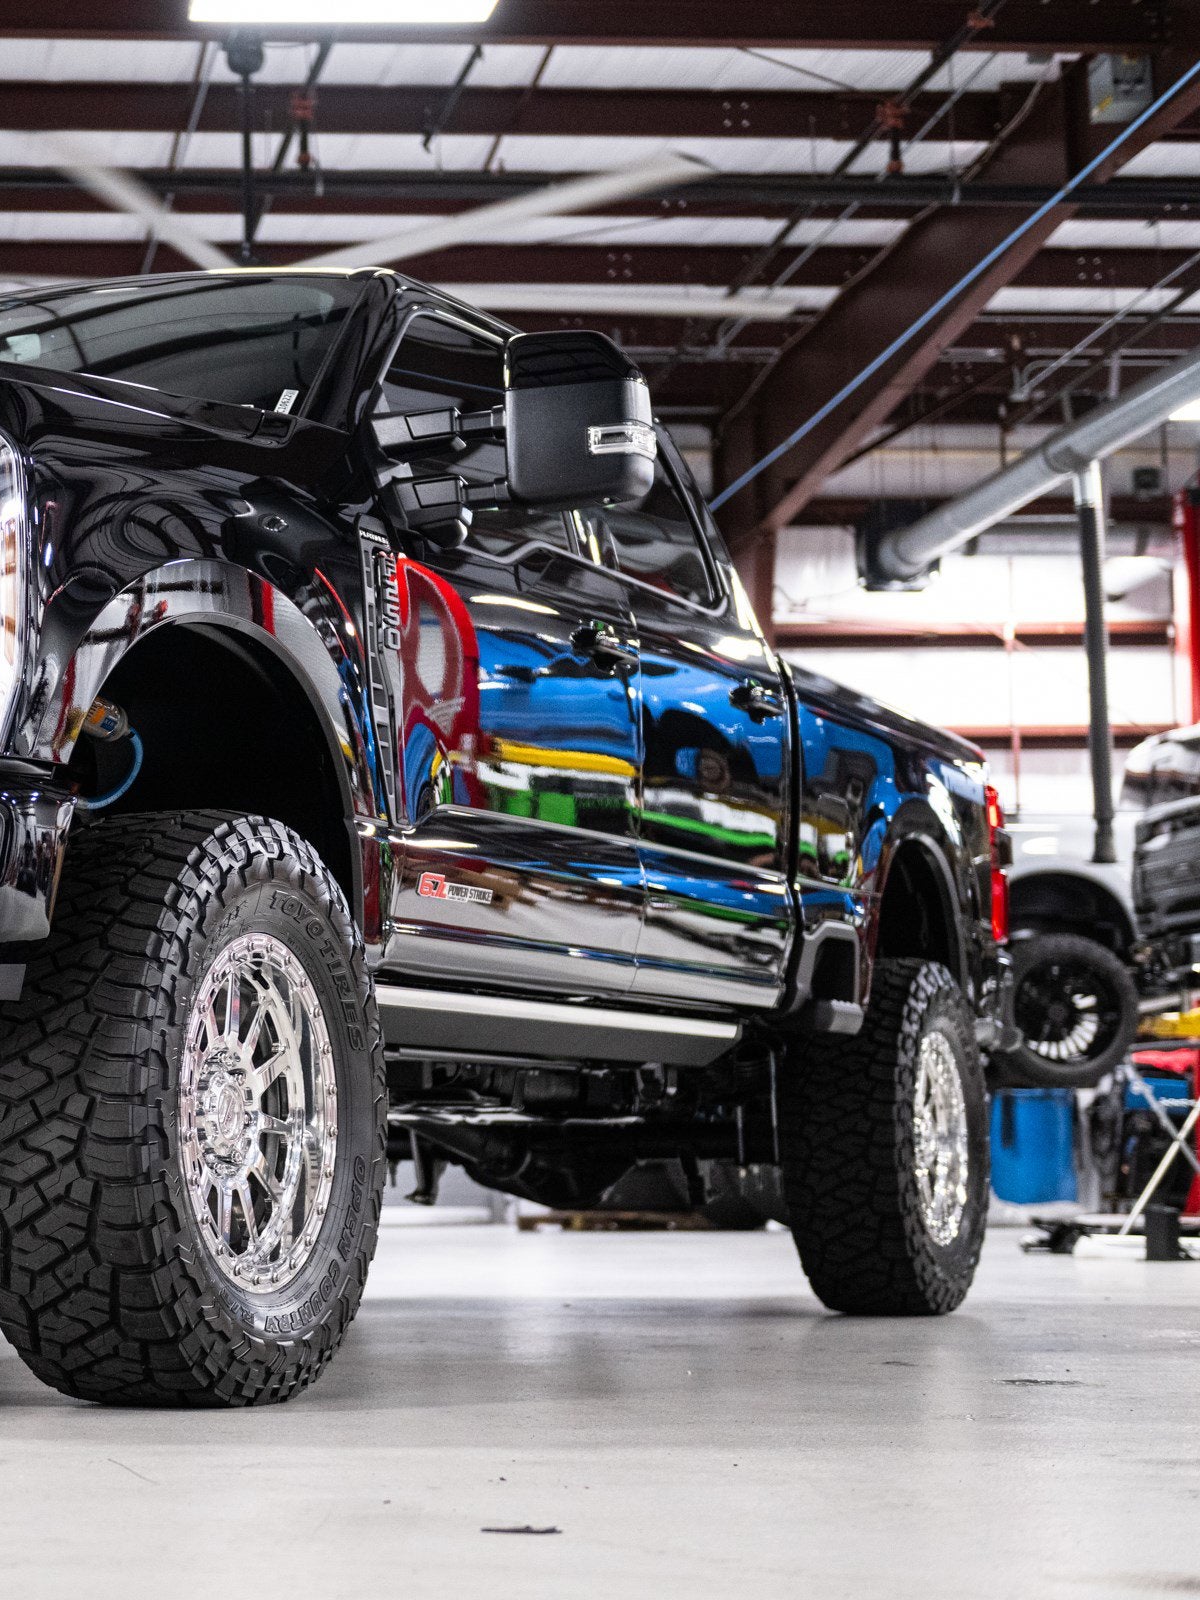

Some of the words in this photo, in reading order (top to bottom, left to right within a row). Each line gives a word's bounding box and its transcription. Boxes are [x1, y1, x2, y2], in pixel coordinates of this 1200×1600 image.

[448, 884, 468, 898] POWER
[469, 888, 492, 902] STROKE
[269, 890, 325, 941] TOYO
[319, 940, 367, 1052] TIRES
[336, 1154, 367, 1262] OPEN
[263, 1259, 342, 1333] COUNTRY
